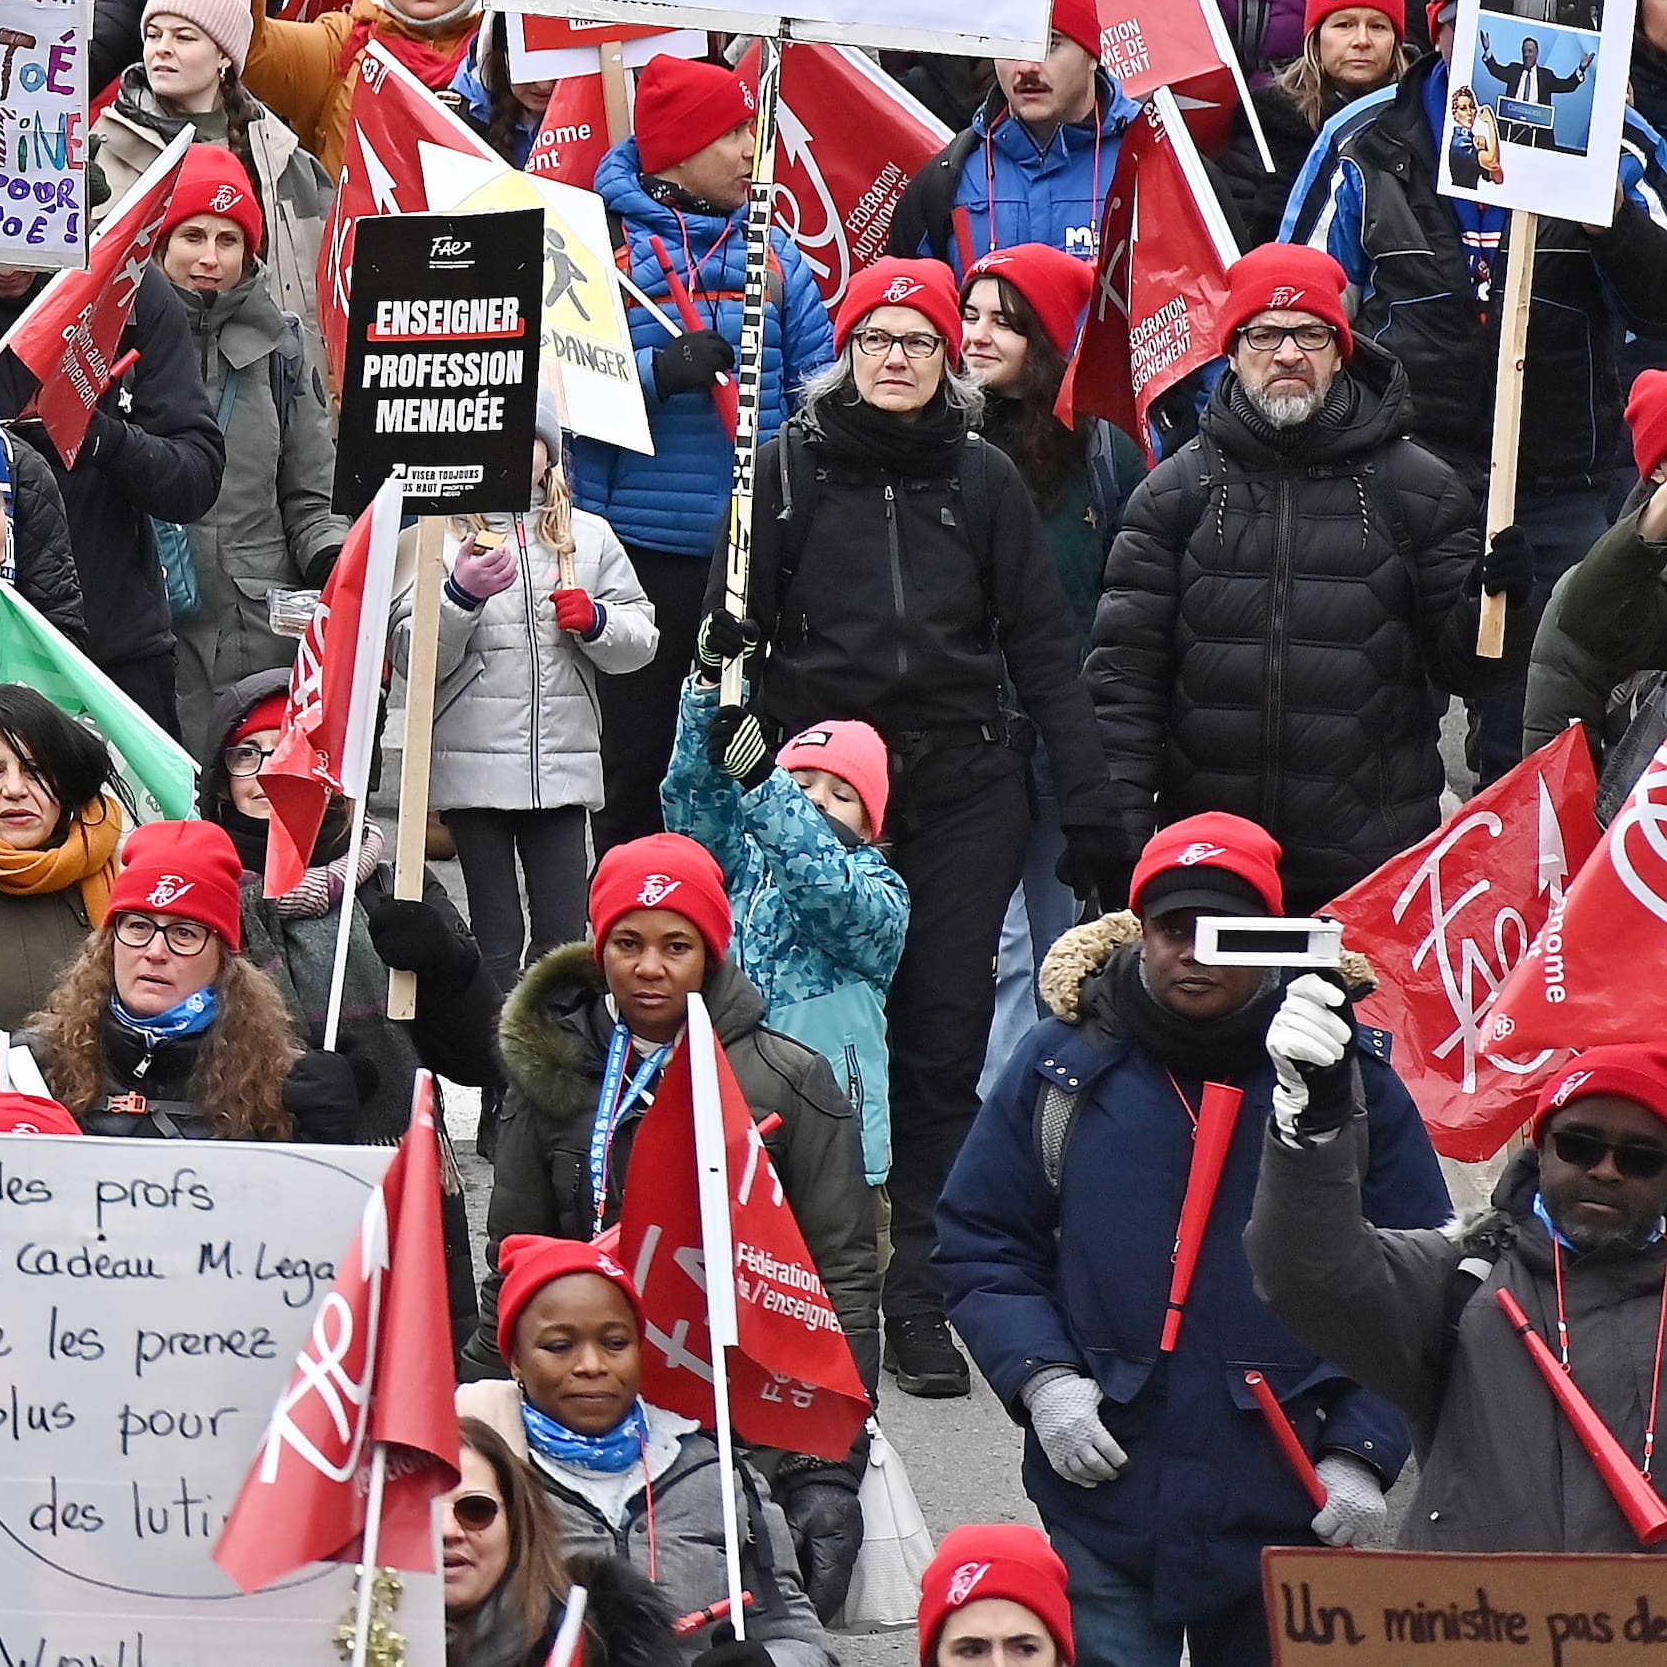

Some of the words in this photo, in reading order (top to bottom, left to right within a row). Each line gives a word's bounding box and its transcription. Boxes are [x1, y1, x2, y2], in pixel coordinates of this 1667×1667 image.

[375, 297, 520, 335] ENSEIGNER
[362, 350, 524, 388] PROFESSION
[554, 328, 634, 382] DANGER
[375, 389, 505, 433] MENACÉE
[411, 470, 436, 480] VISER
[438, 468, 480, 481] TOUJOURS
[416, 483, 438, 493] HAUT
[97, 1170, 215, 1227] profs
[17, 1241, 163, 1281] cadeau
[198, 1242, 243, 1277] M.
[51, 1309, 104, 1360] les
[136, 1328, 277, 1379] prenez
[120, 1407, 240, 1457] pour
[29, 1479, 104, 1534] des
[1281, 1582, 1365, 1645] Un
[1384, 1587, 1531, 1643] ministre
[1546, 1611, 1615, 1667] pas
